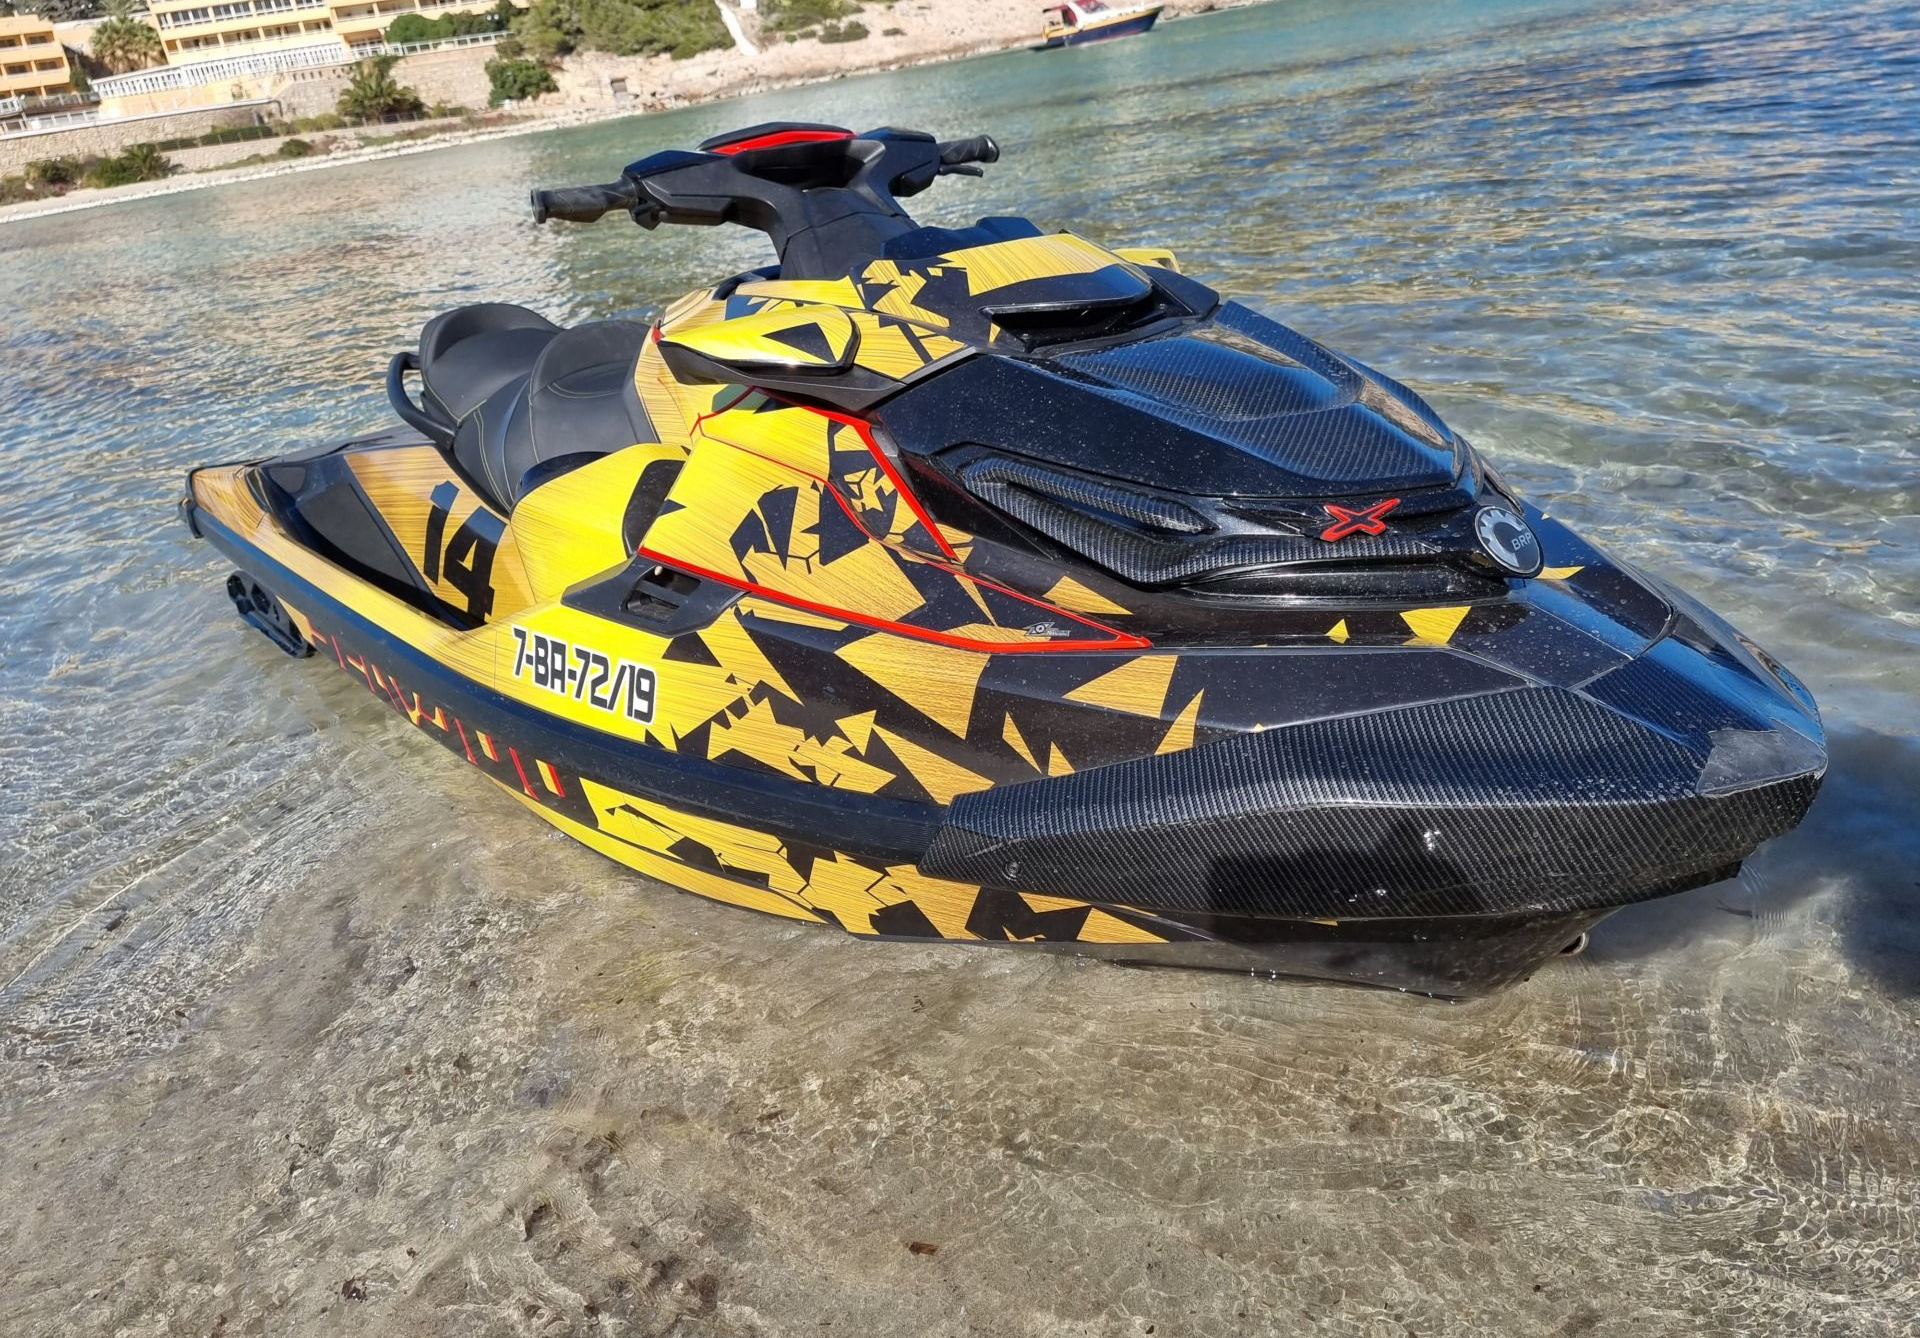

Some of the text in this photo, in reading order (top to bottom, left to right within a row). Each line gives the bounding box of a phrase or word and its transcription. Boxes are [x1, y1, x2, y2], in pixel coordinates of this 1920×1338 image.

[424, 479, 507, 622] 14
[1511, 532, 1532, 551] BRP
[511, 625, 657, 725] 7-BA-72/19
